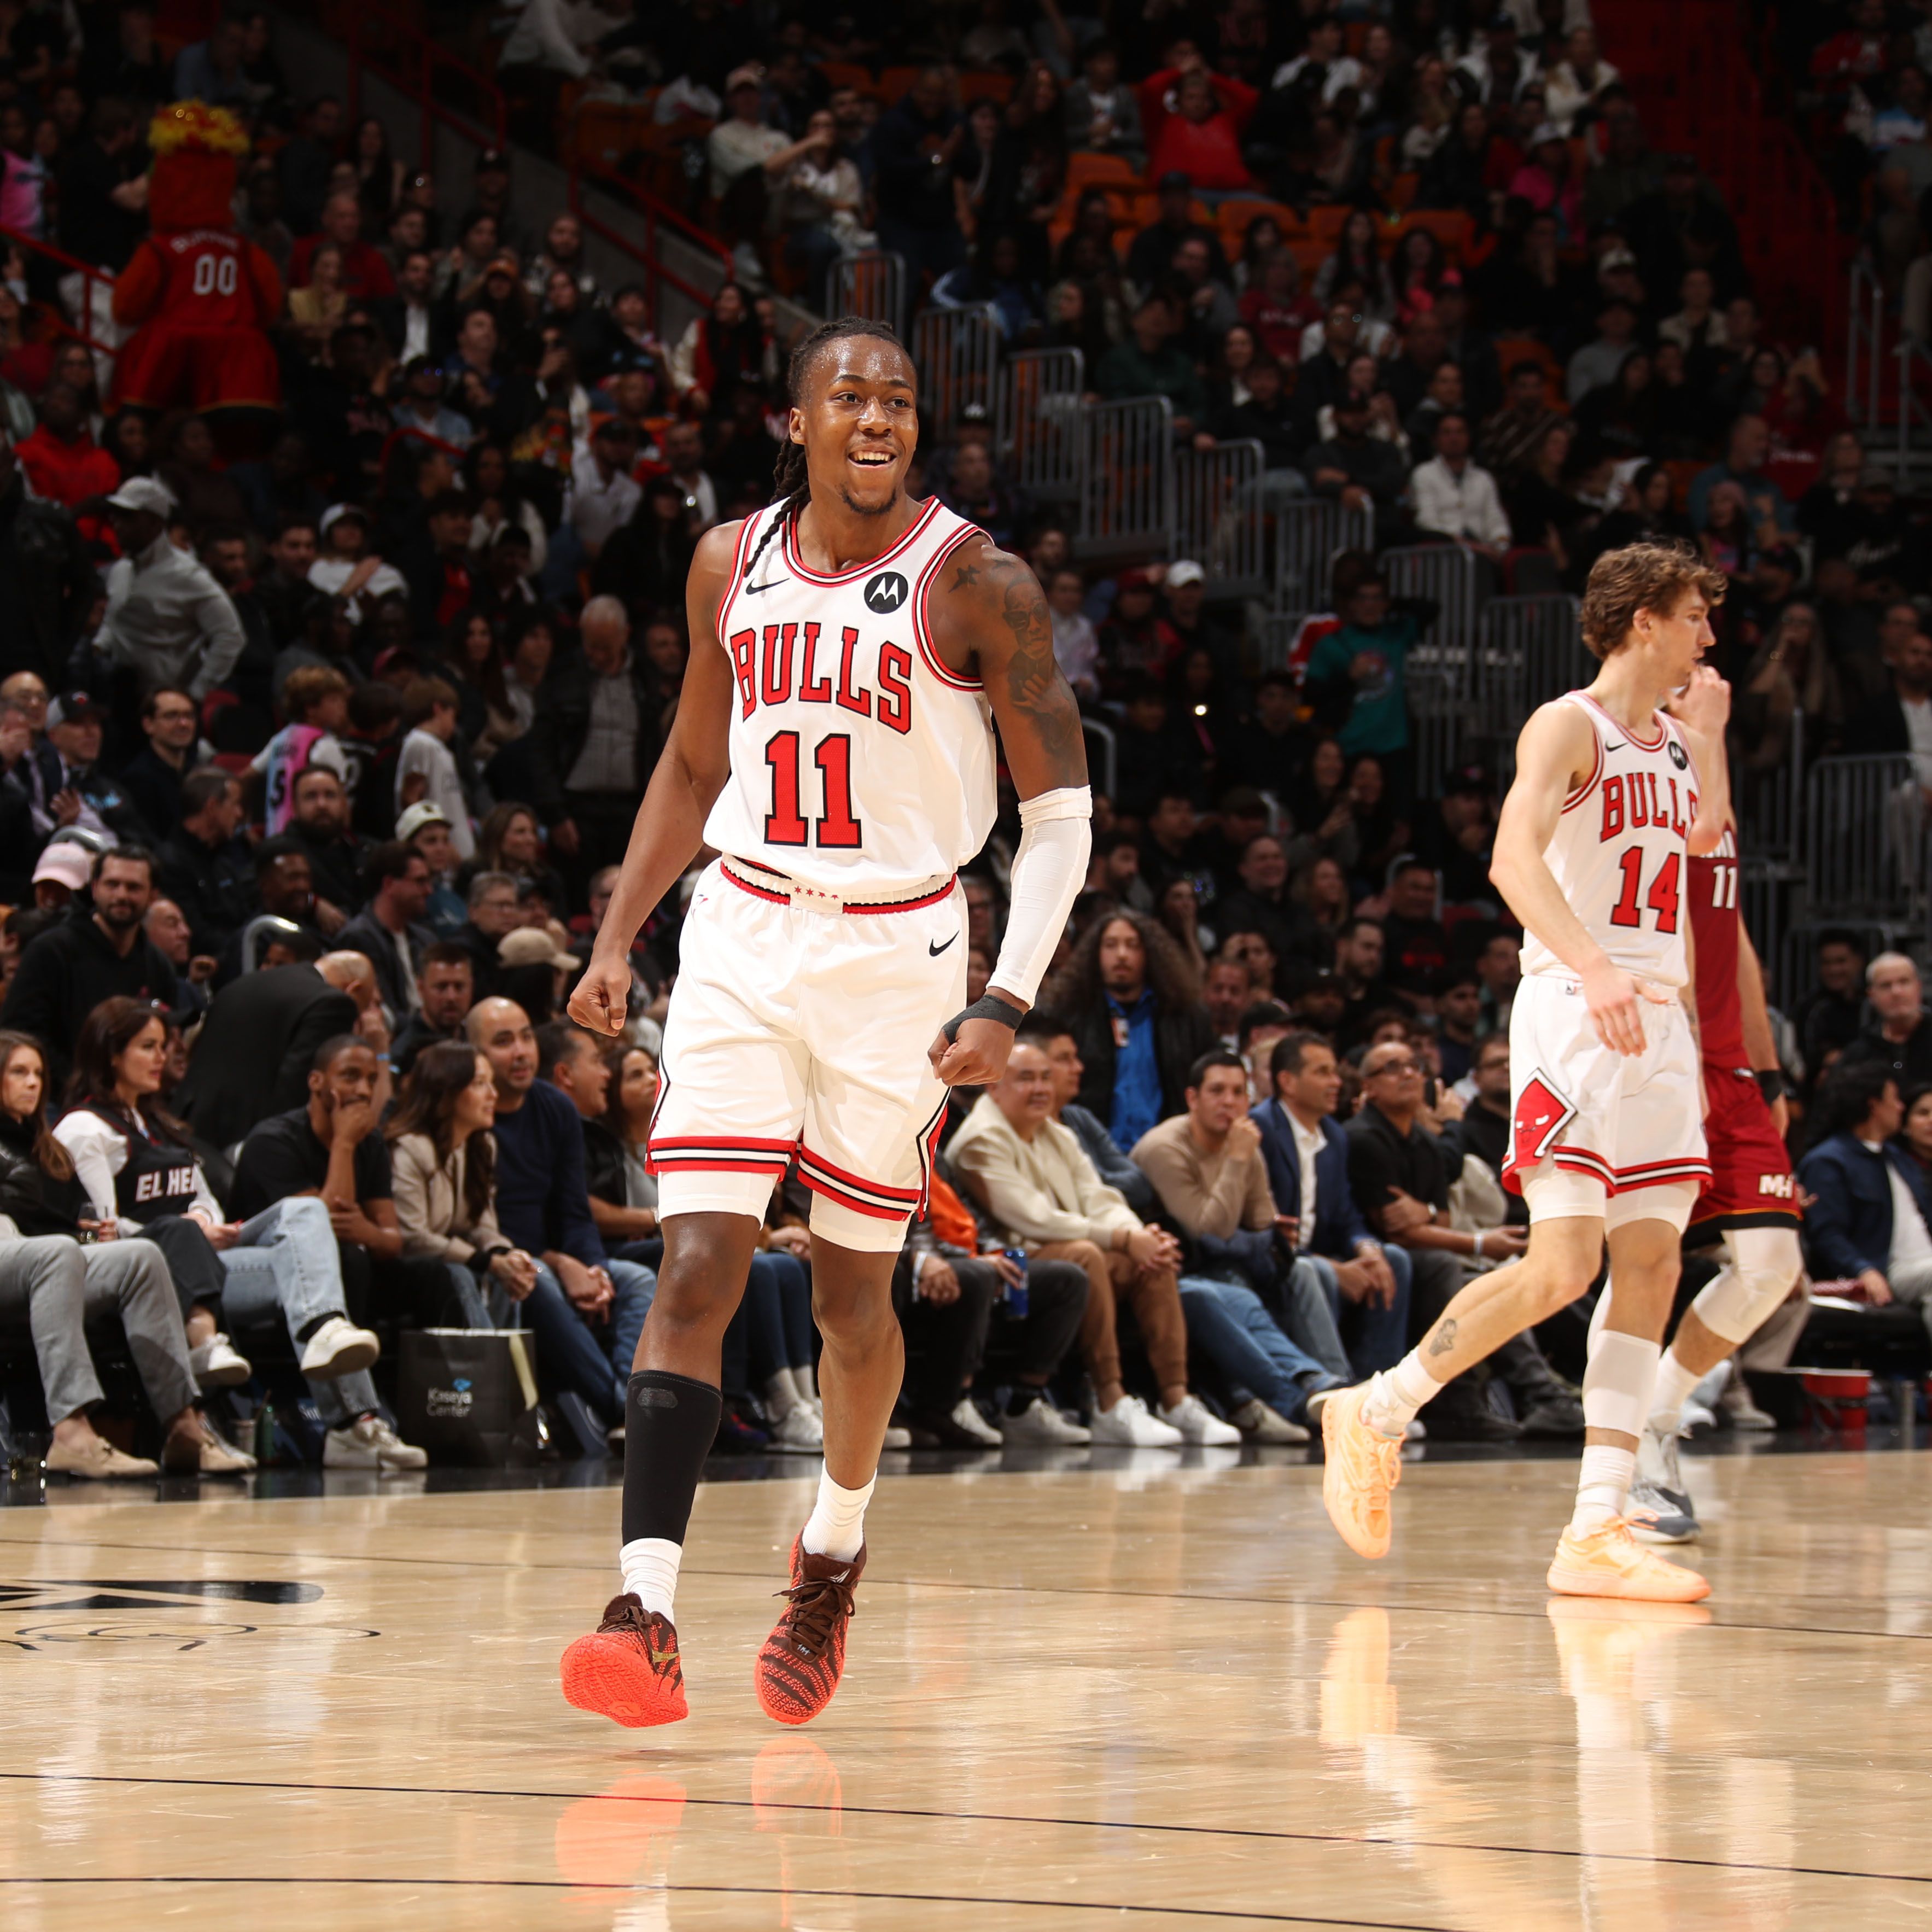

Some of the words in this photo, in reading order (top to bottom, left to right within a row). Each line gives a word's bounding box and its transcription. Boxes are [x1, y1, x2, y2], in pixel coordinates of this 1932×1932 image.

[192, 252, 238, 297] 00
[729, 621, 912, 736] BULLS
[763, 730, 862, 849] 11
[1609, 845, 1680, 935] 14
[1712, 864, 1737, 909] 11
[135, 1170, 164, 1203] EL
[166, 1166, 195, 1197] HE
[1759, 1174, 1794, 1199] MH
[425, 1403, 471, 1418] Center
[427, 1387, 473, 1407] Kaseya
